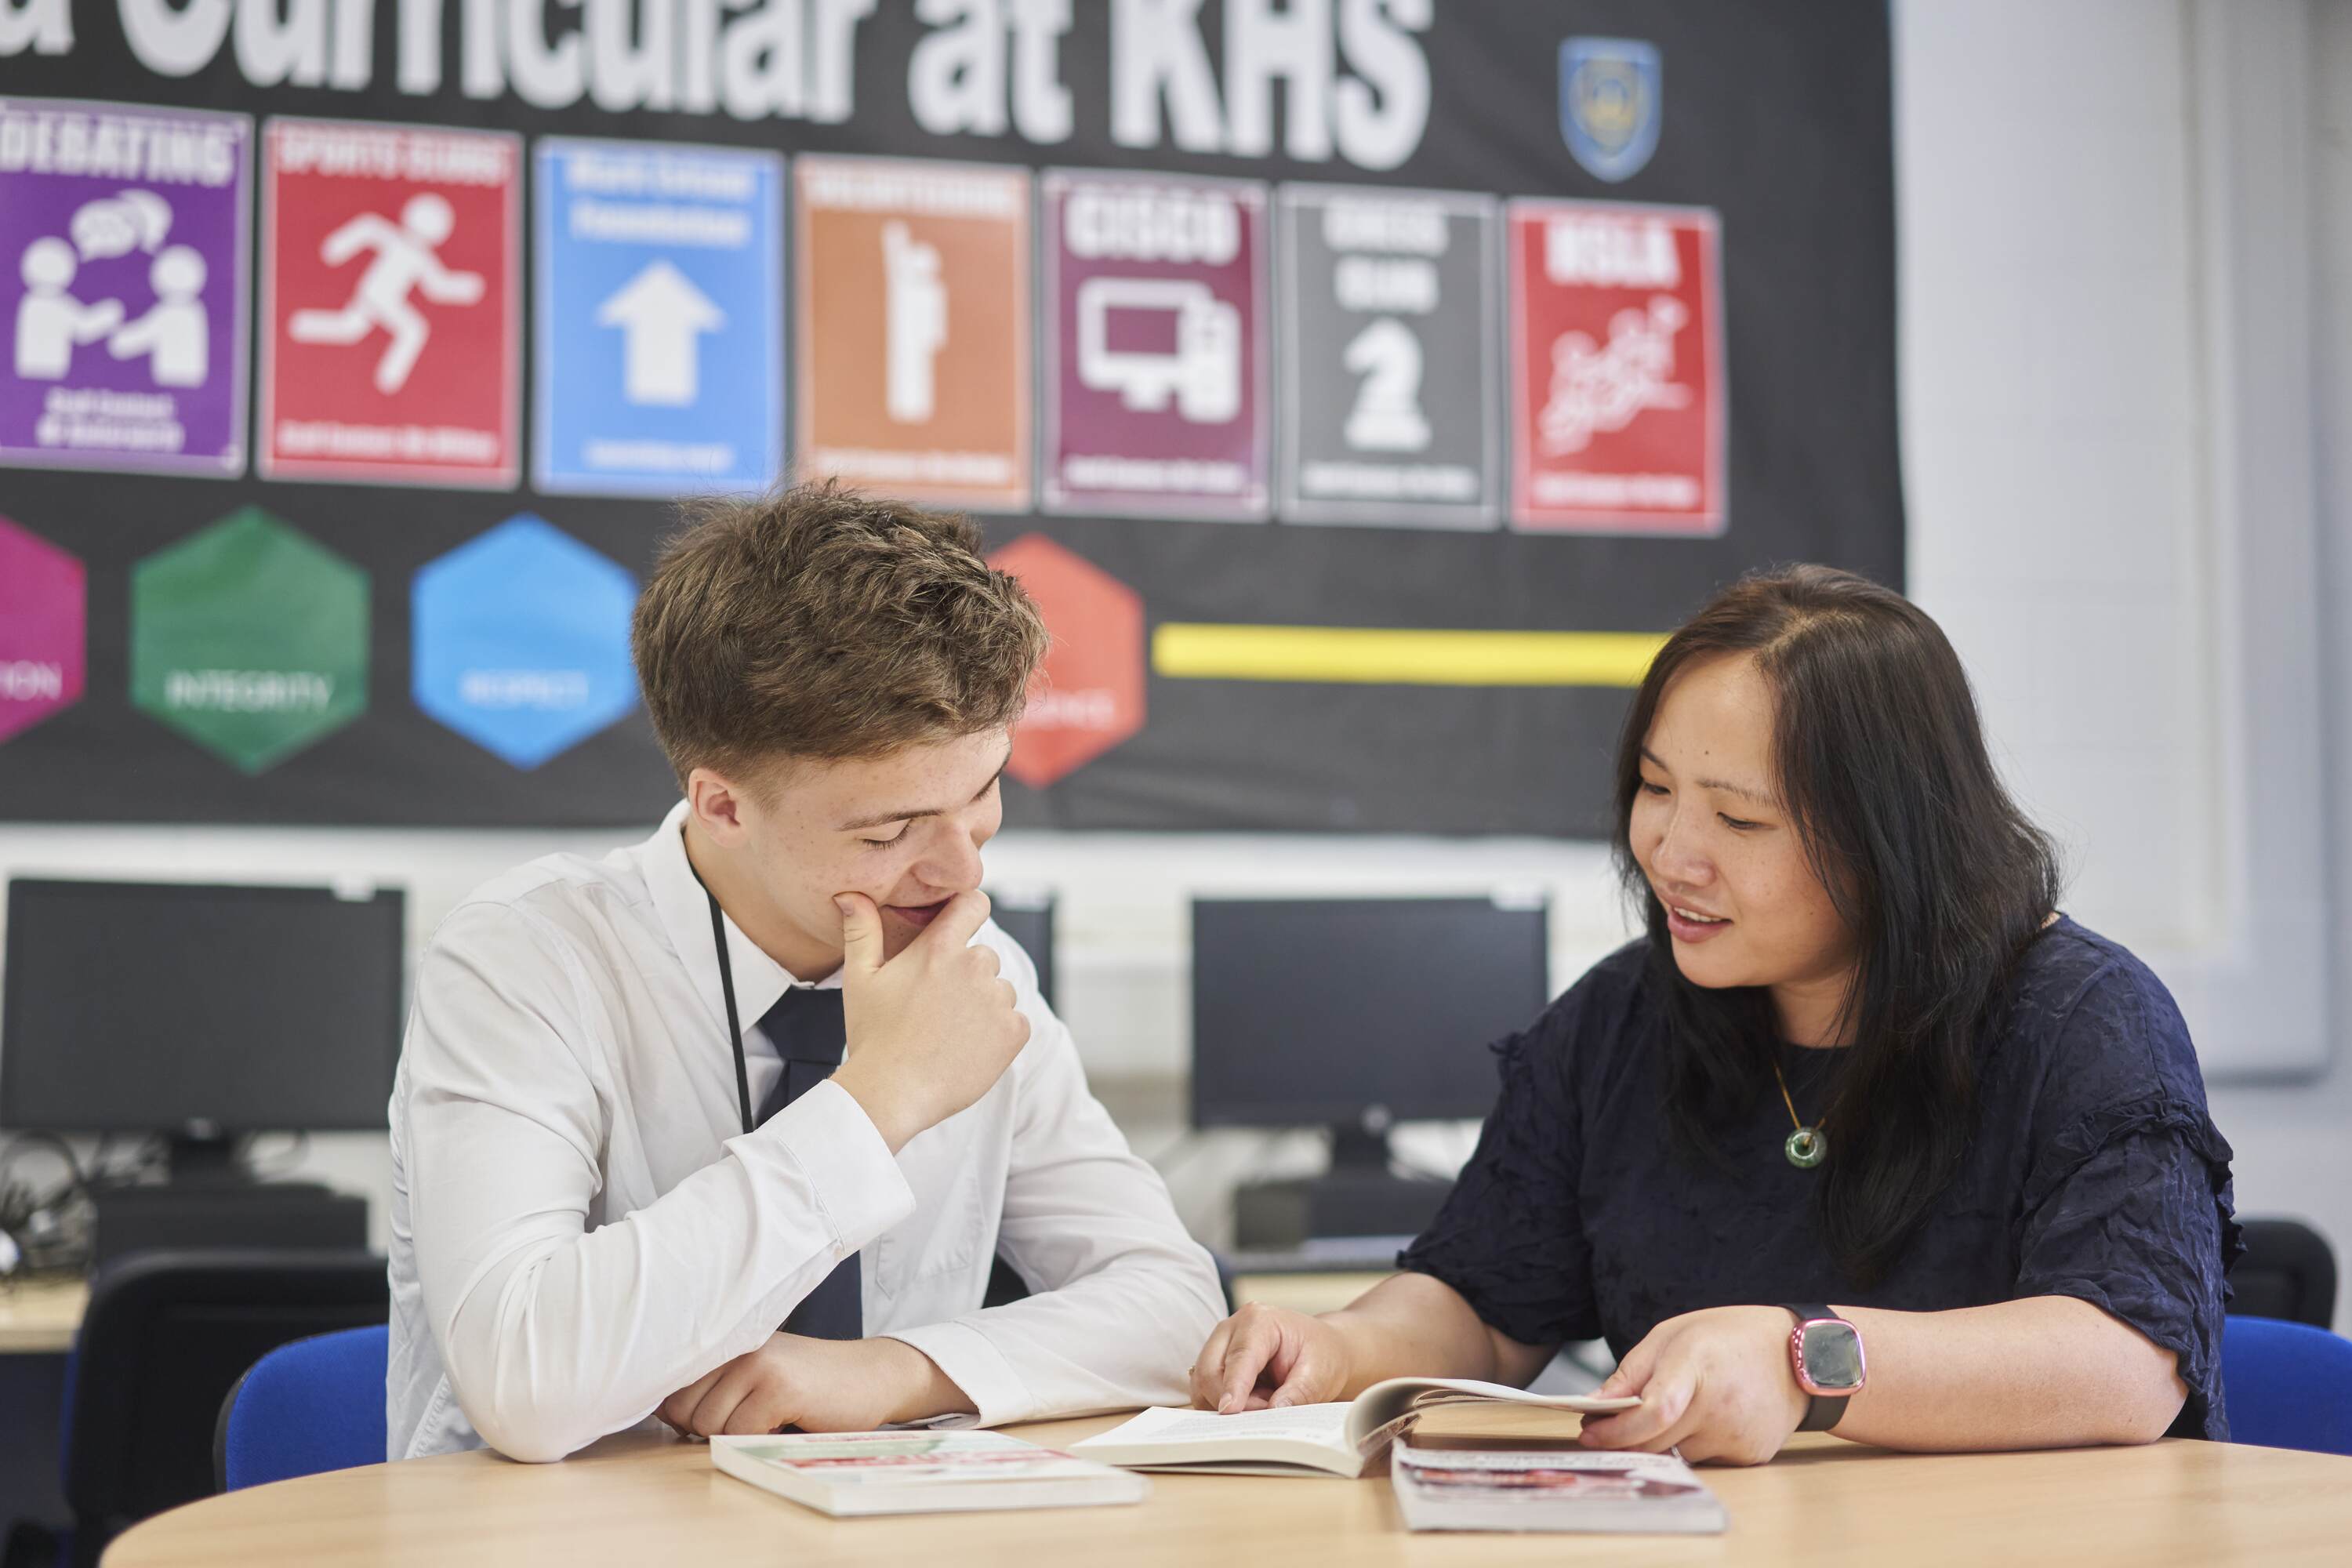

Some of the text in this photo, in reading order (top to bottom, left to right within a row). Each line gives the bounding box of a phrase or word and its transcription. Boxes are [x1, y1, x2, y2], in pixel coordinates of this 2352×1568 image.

[908, 0, 1074, 143] at
[1110, 0, 1433, 169] KHS
[164, 670, 334, 711] INTEGRITY
